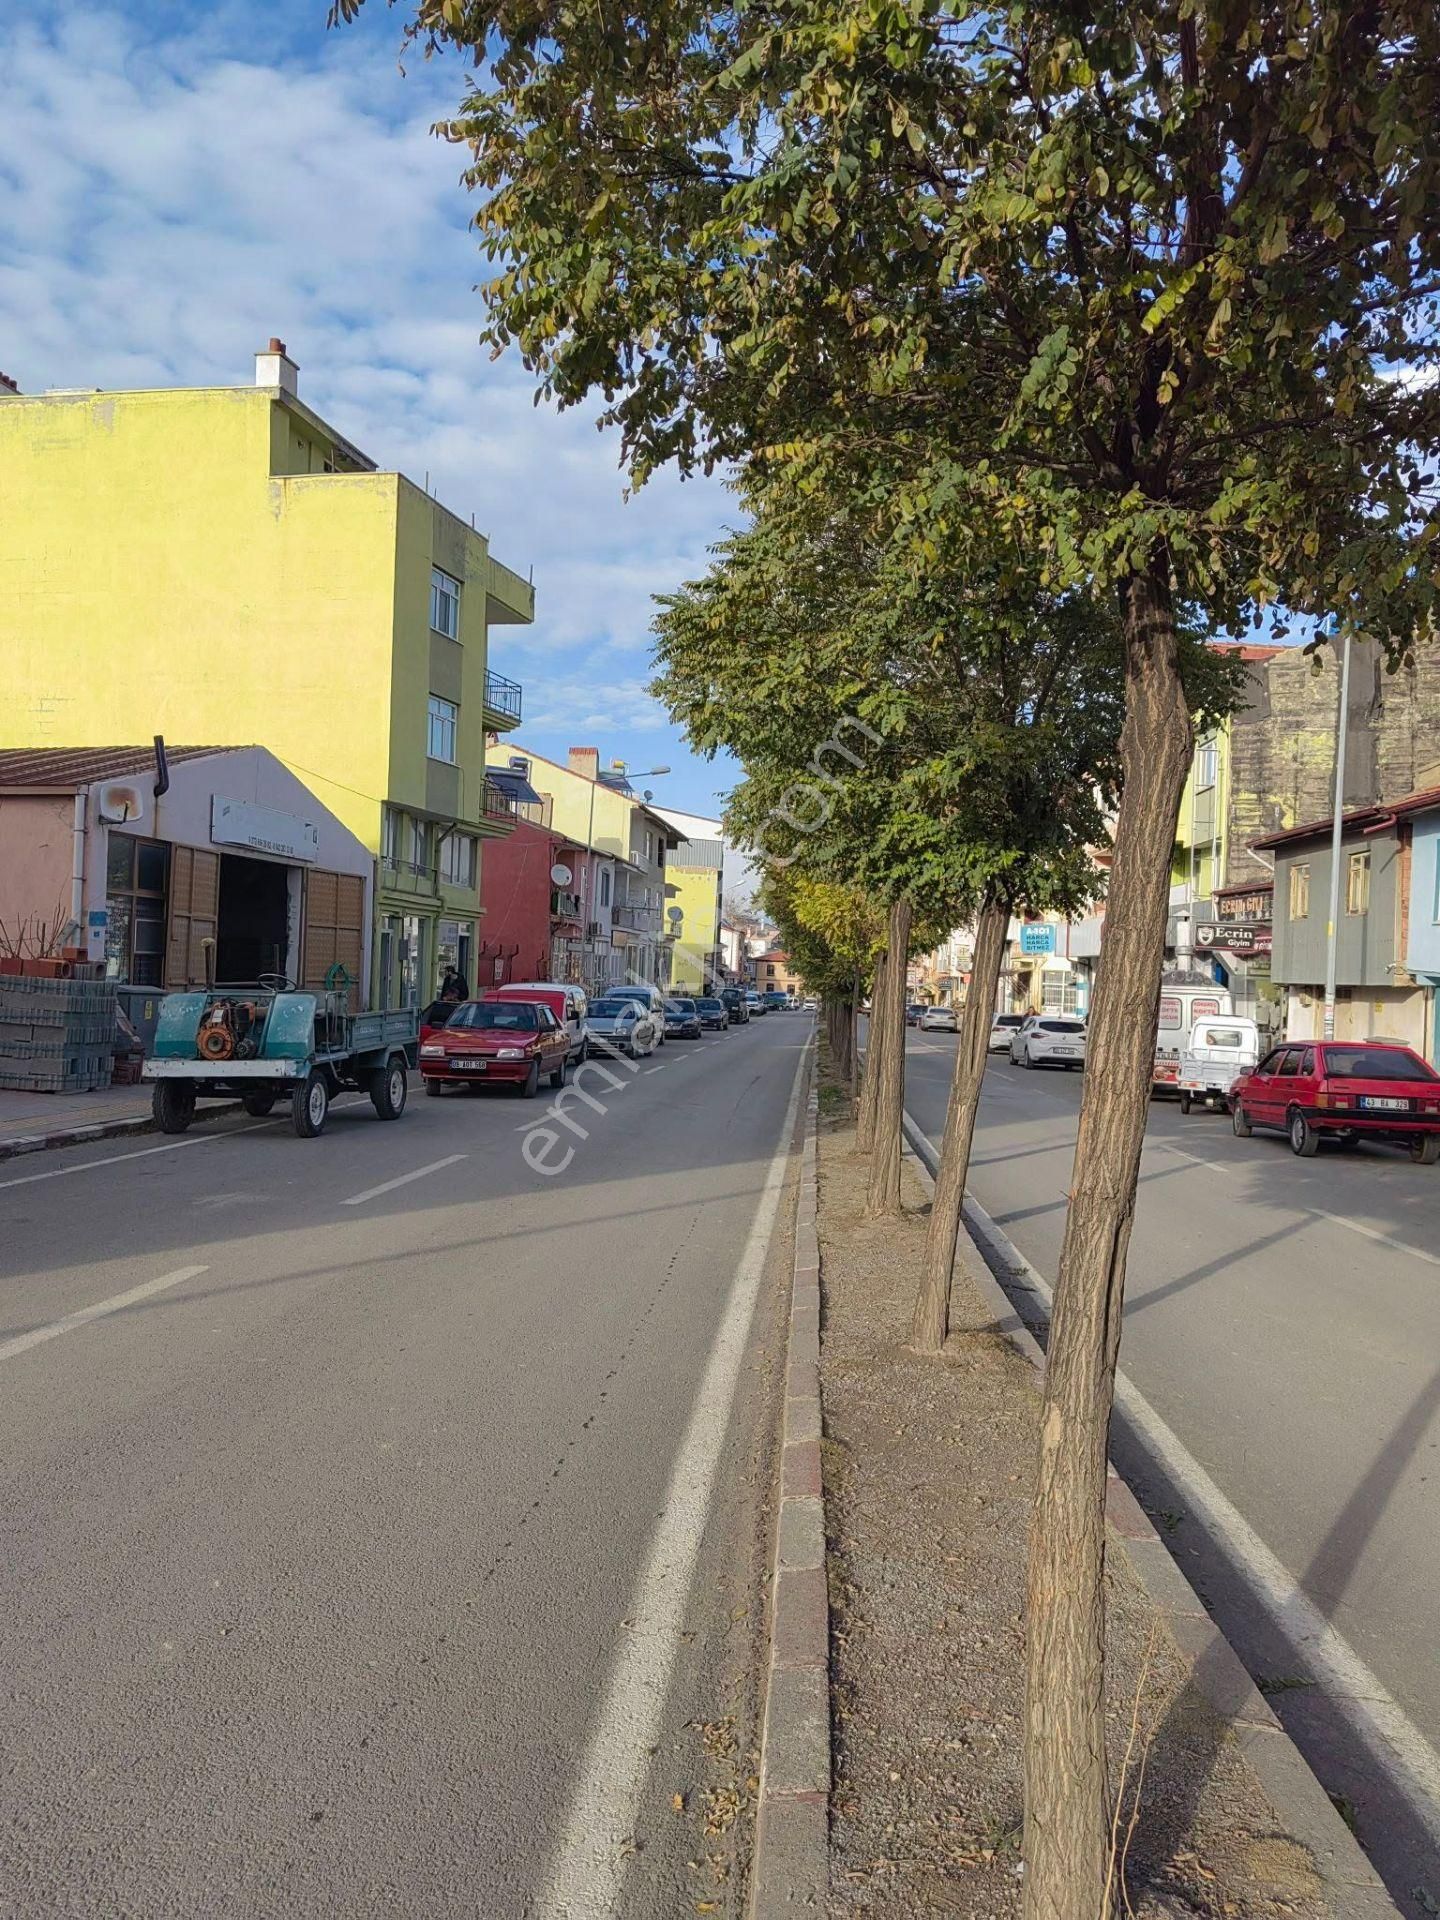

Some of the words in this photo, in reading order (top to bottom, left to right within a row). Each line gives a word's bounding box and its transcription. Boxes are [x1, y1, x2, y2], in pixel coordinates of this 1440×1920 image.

[1026, 927, 1050, 935] A101
[1215, 926, 1253, 938] Ecrin
[1228, 939, 1250, 948] Giyim
[1366, 1098, 1375, 1106] 43
